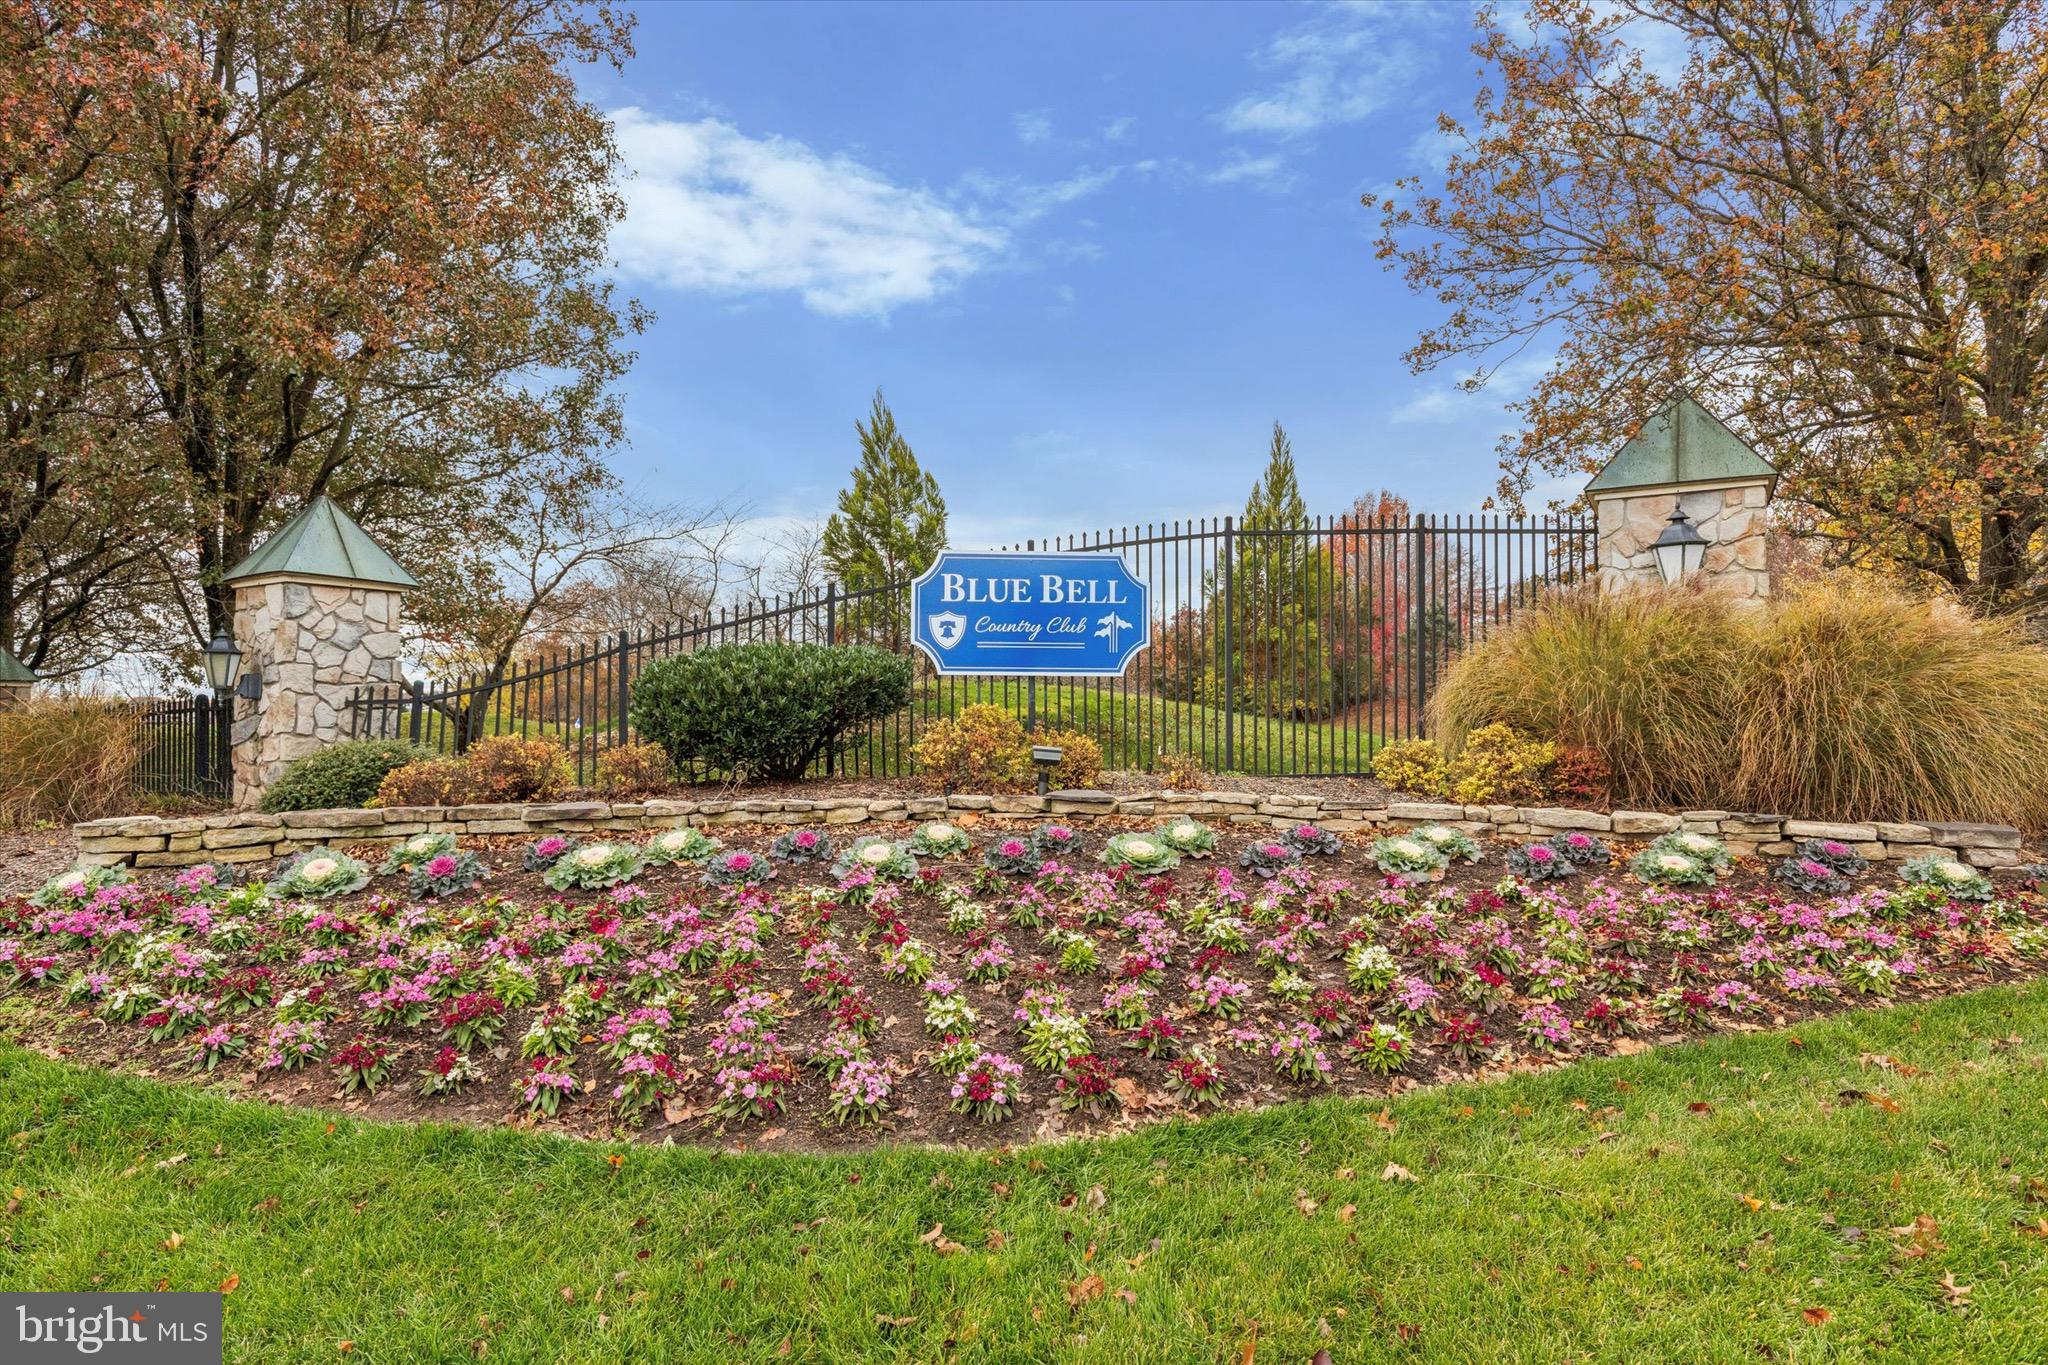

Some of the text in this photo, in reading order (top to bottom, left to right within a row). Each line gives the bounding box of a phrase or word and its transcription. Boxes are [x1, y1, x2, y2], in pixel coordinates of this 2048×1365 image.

[941, 573, 1127, 604] BLUE BELL
[975, 615, 1087, 641] Country Club
